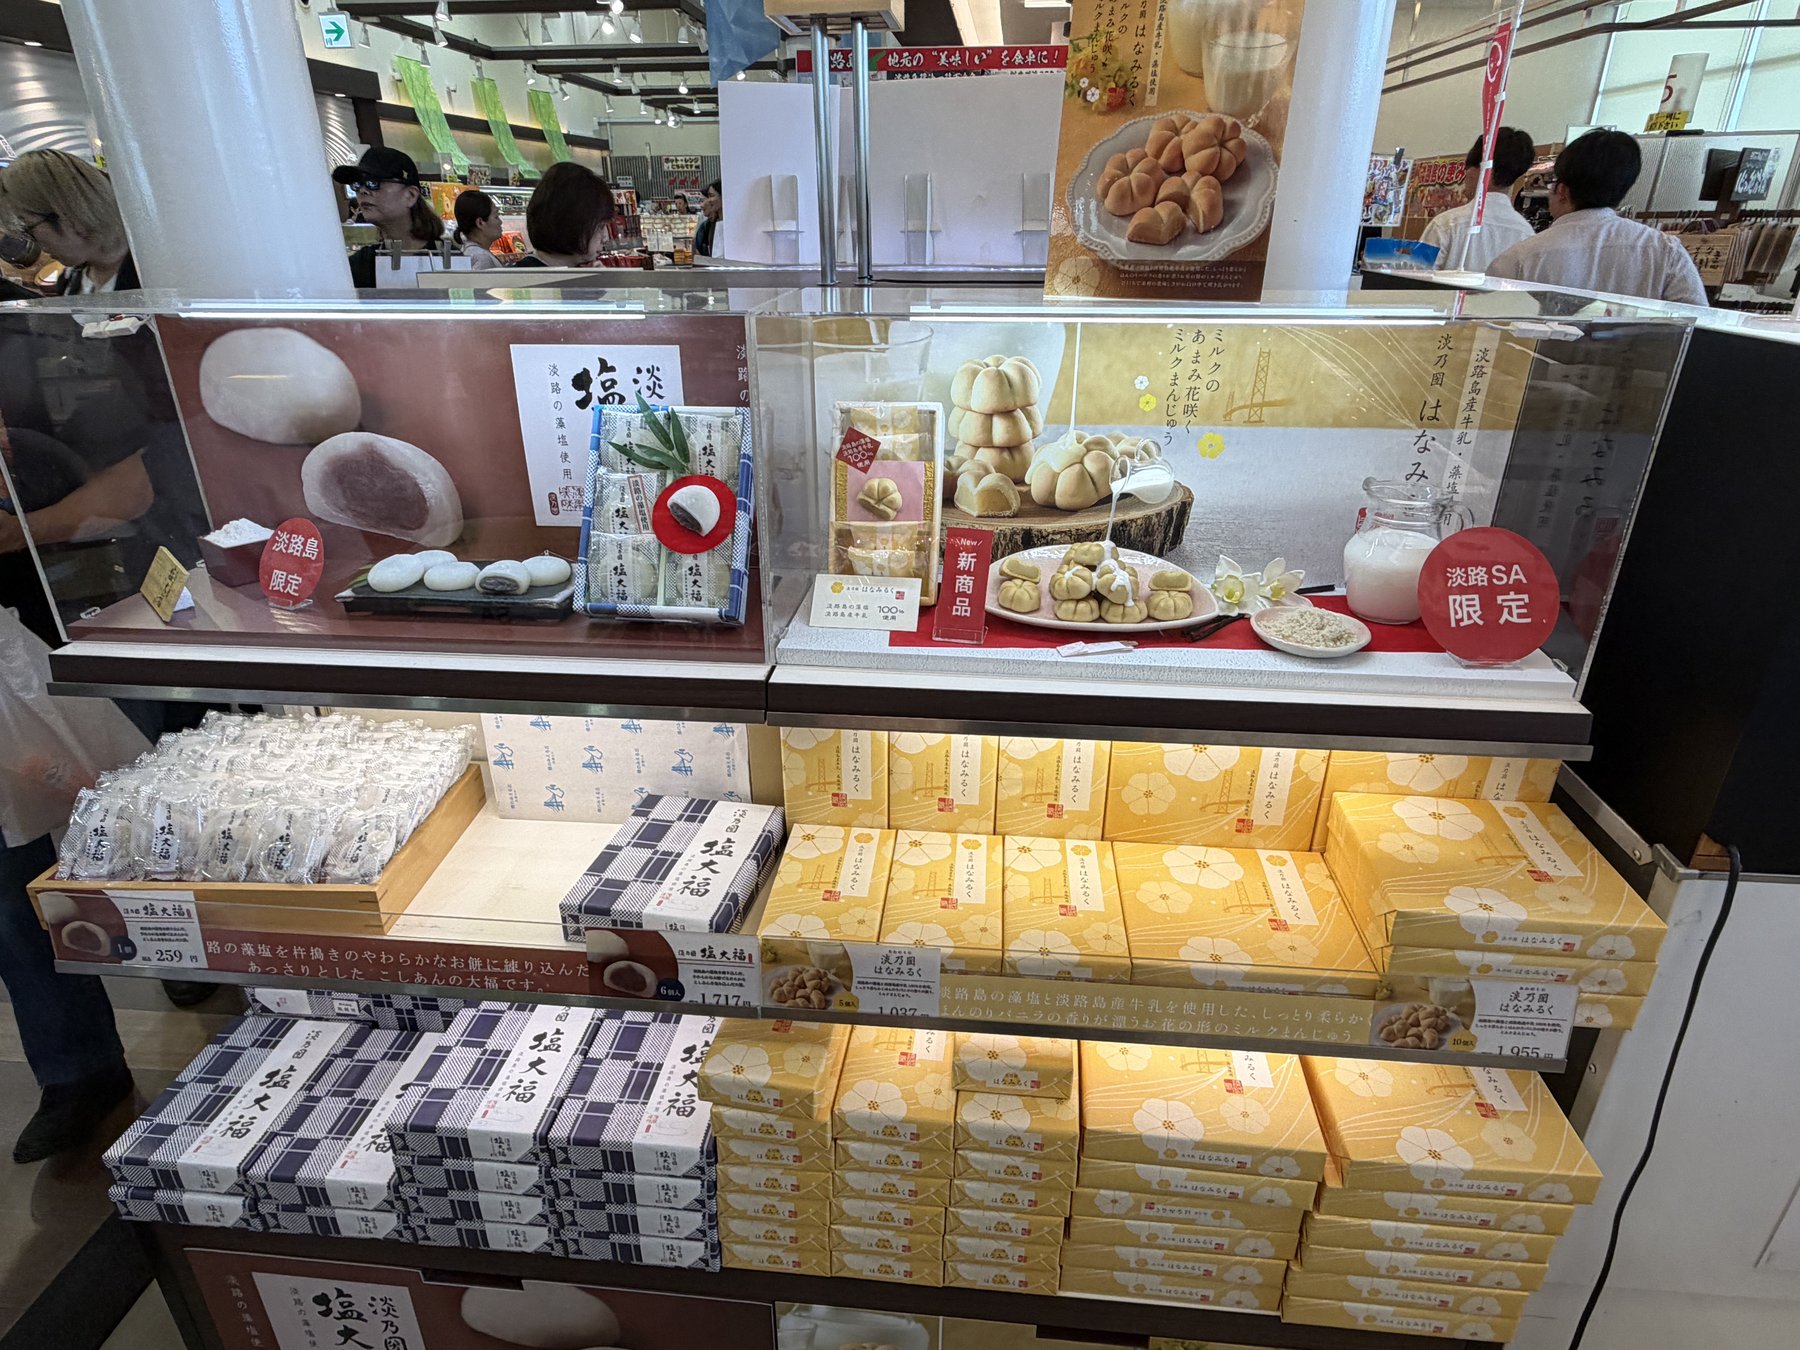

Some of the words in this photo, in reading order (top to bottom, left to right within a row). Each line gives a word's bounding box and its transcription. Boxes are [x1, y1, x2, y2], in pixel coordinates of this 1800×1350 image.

[1102, 0, 1117, 67] まみ花咲く
[1129, 25, 1147, 107] はなみるく
[1205, 328, 1225, 393] ミルクの
[1163, 328, 1186, 446] ミルクまんじゅう
[1182, 329, 1206, 435] あまみ花咲く
[548, 363, 573, 480] 淡路の藻塩使用
[614, 506, 630, 535] 塩大
[271, 530, 320, 562] 淡路島
[960, 538, 978, 547] New
[269, 569, 303, 597] 限定
[612, 562, 629, 602] 塩大福
[688, 562, 703, 602] 塩大福
[861, 586, 894, 594] はなみるく
[951, 551, 977, 618] 新商品
[1446, 564, 1528, 588] 淡路SA
[1447, 591, 1532, 628] 限定
[851, 745, 861, 792] はなみるく
[959, 750, 970, 797] はなみるく
[1070, 755, 1082, 803] はなみるく
[1263, 771, 1279, 820] はなみるく
[676, 837, 734, 898] 塩大福
[850, 857, 863, 891] はなみるく
[965, 863, 975, 898] はなみるく
[1079, 870, 1091, 905] はなみるく
[1281, 883, 1302, 920] はなみるく
[142, 902, 186, 917] 塩大福
[155, 949, 183, 963] 259
[700, 945, 746, 961] 塩大福
[1520, 935, 1562, 946] はなみるく
[874, 965, 922, 977] はなみるく
[1515, 967, 1557, 978] はなみるく
[877, 1006, 918, 1016] 1037
[1499, 1003, 1554, 1015] はなみるく
[501, 1028, 565, 1104] 塩大福
[1497, 1045, 1540, 1058] 1955
[663, 1040, 713, 1118] 塩大福
[219, 1065, 298, 1139] 塩大福
[1198, 1154, 1236, 1164] はなみるく
[1191, 1185, 1227, 1195] はなみるく
[1467, 1183, 1506, 1192] はなみるく
[1440, 1213, 1479, 1222] はなみるく
[1178, 1237, 1214, 1246] はなみるく
[1426, 1241, 1464, 1250] はなみるく
